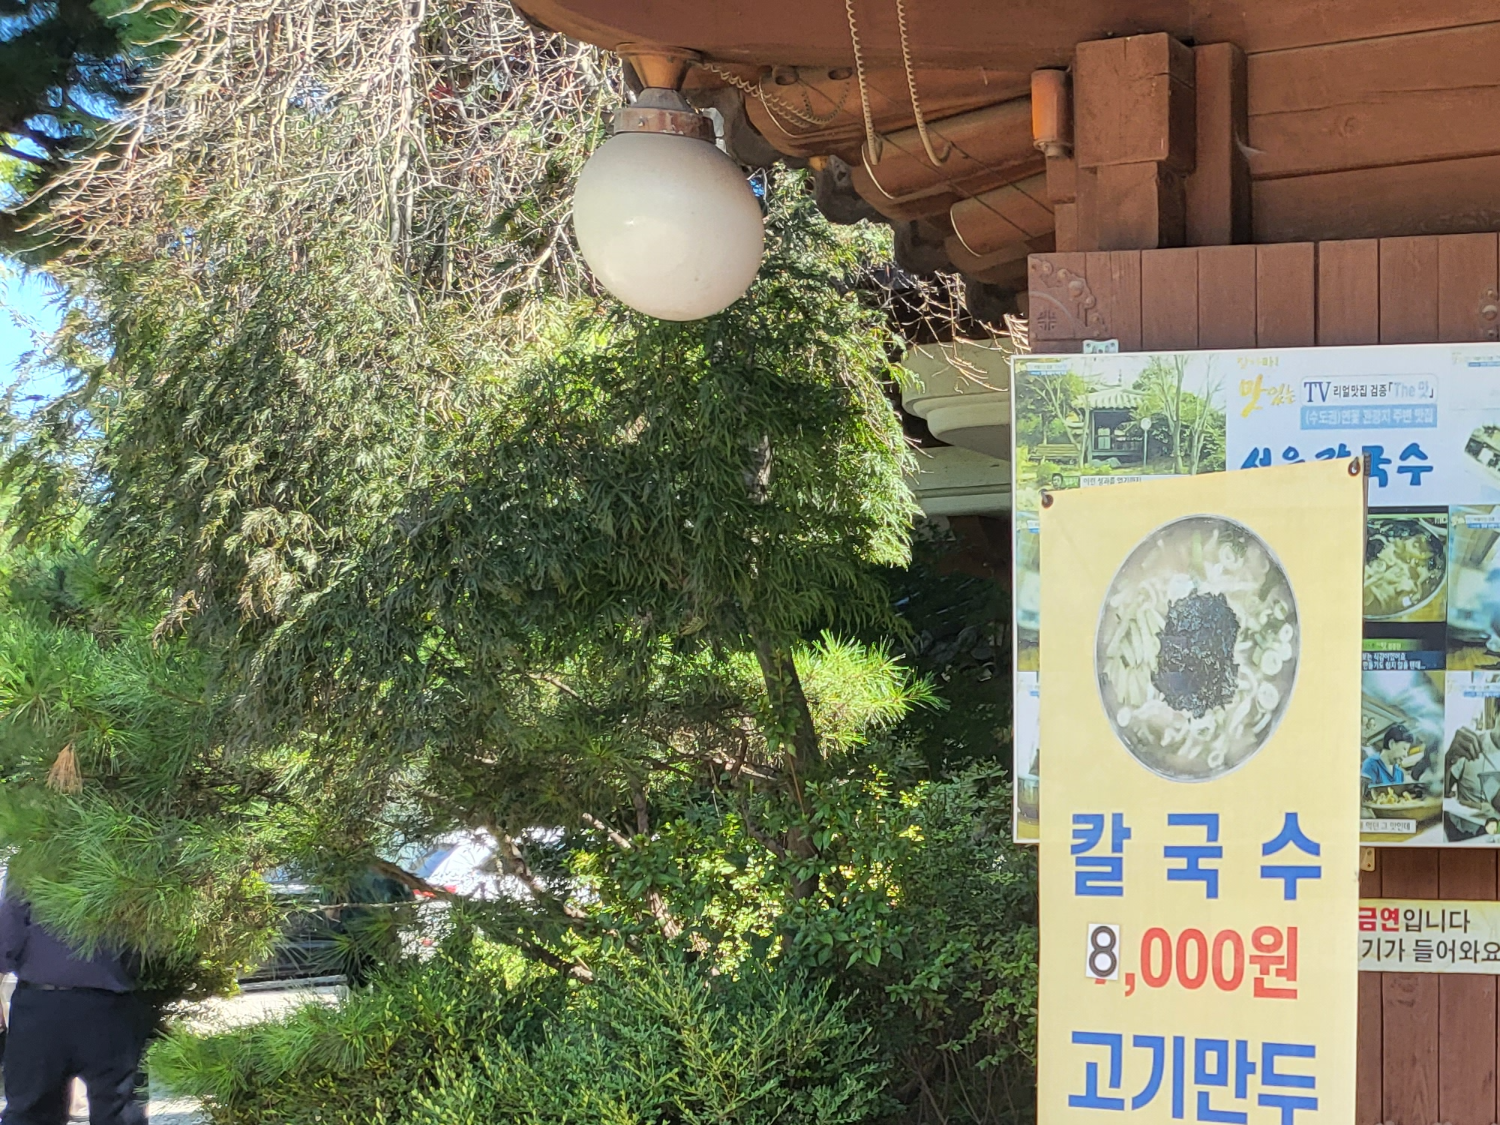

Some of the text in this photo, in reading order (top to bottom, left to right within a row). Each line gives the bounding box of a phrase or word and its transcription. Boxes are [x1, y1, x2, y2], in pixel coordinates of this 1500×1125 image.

[1303, 381, 1333, 402] TV
[1333, 385, 1367, 398] 리얼맛집
[1087, 925, 1298, 1000] 8,000원
